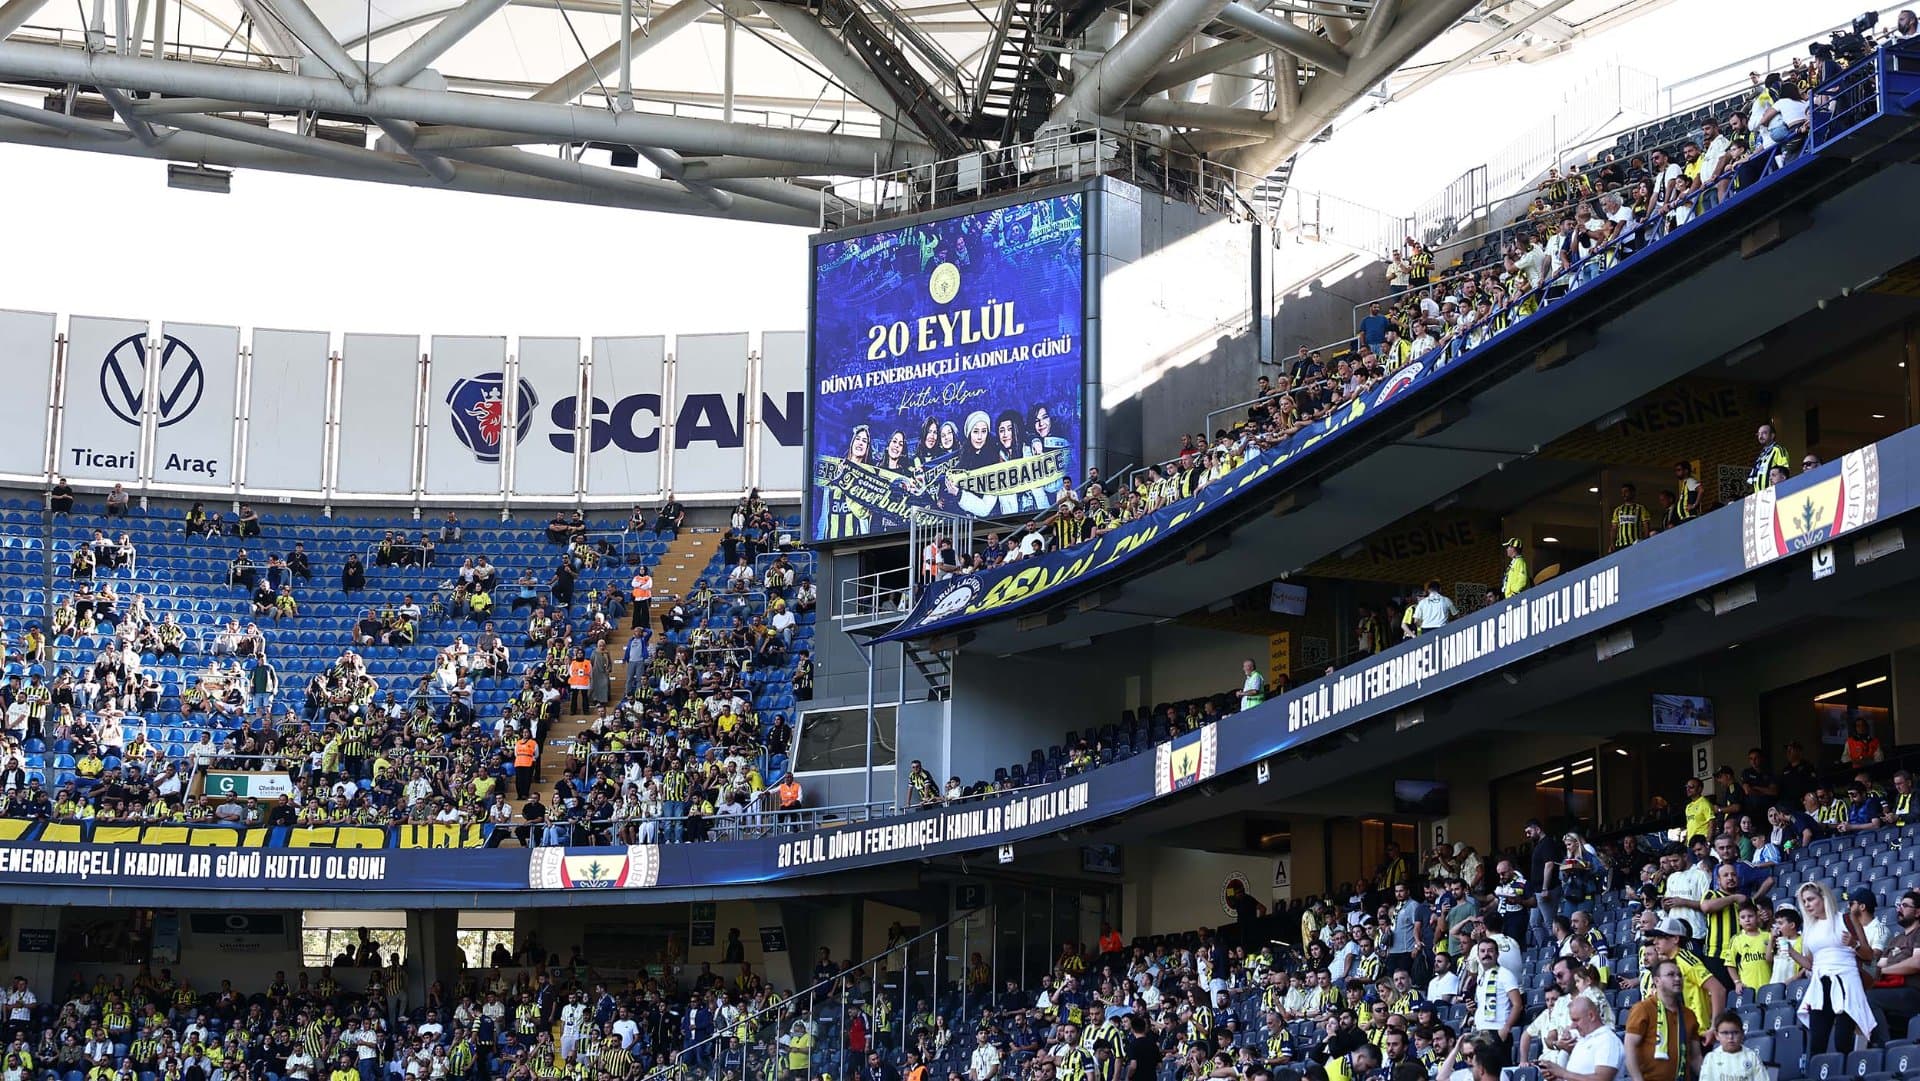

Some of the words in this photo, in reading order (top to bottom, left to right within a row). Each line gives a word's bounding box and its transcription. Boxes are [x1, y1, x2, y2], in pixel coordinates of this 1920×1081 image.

[867, 321, 910, 361] 20
[917, 298, 1025, 352] EYLÜL
[821, 374, 863, 395] DÜNYA
[866, 352, 960, 388] FENERBAHÇELİ
[962, 345, 1029, 372] KADINLAR
[1031, 334, 1071, 359] GÜNÜ
[898, 386, 939, 415] Kutlu
[72, 449, 135, 469] Ticari
[164, 453, 217, 477] Araç
[1288, 698, 1300, 733] 20
[1302, 684, 1331, 728] EYLÜL
[1332, 673, 1363, 715] DÜNYA
[1442, 618, 1495, 672] KADINLAR
[1498, 598, 1528, 649] GÜNÜ
[1531, 585, 1570, 636] KUTLU
[1573, 565, 1619, 619] OLSUN!
[1697, 747, 1708, 773] B
[220, 777, 234, 792] G
[778, 843, 792, 868] 20
[793, 834, 826, 866] EYLÜL
[829, 830, 862, 860] DÜNYA
[865, 813, 944, 854] FENERBAHÇELİ
[946, 807, 1001, 841] KADINLAR
[1004, 796, 1028, 831] GÜNÜ
[1029, 791, 1057, 825] KUTLU
[1058, 782, 1088, 817] OLSUN!
[1436, 825, 1444, 846] B
[124, 852, 211, 878] KADINLAR
[216, 851, 261, 878] GÜNÜ
[265, 855, 321, 879] KUTLU
[326, 856, 386, 880] OLSUN!
[1275, 861, 1287, 881] A
